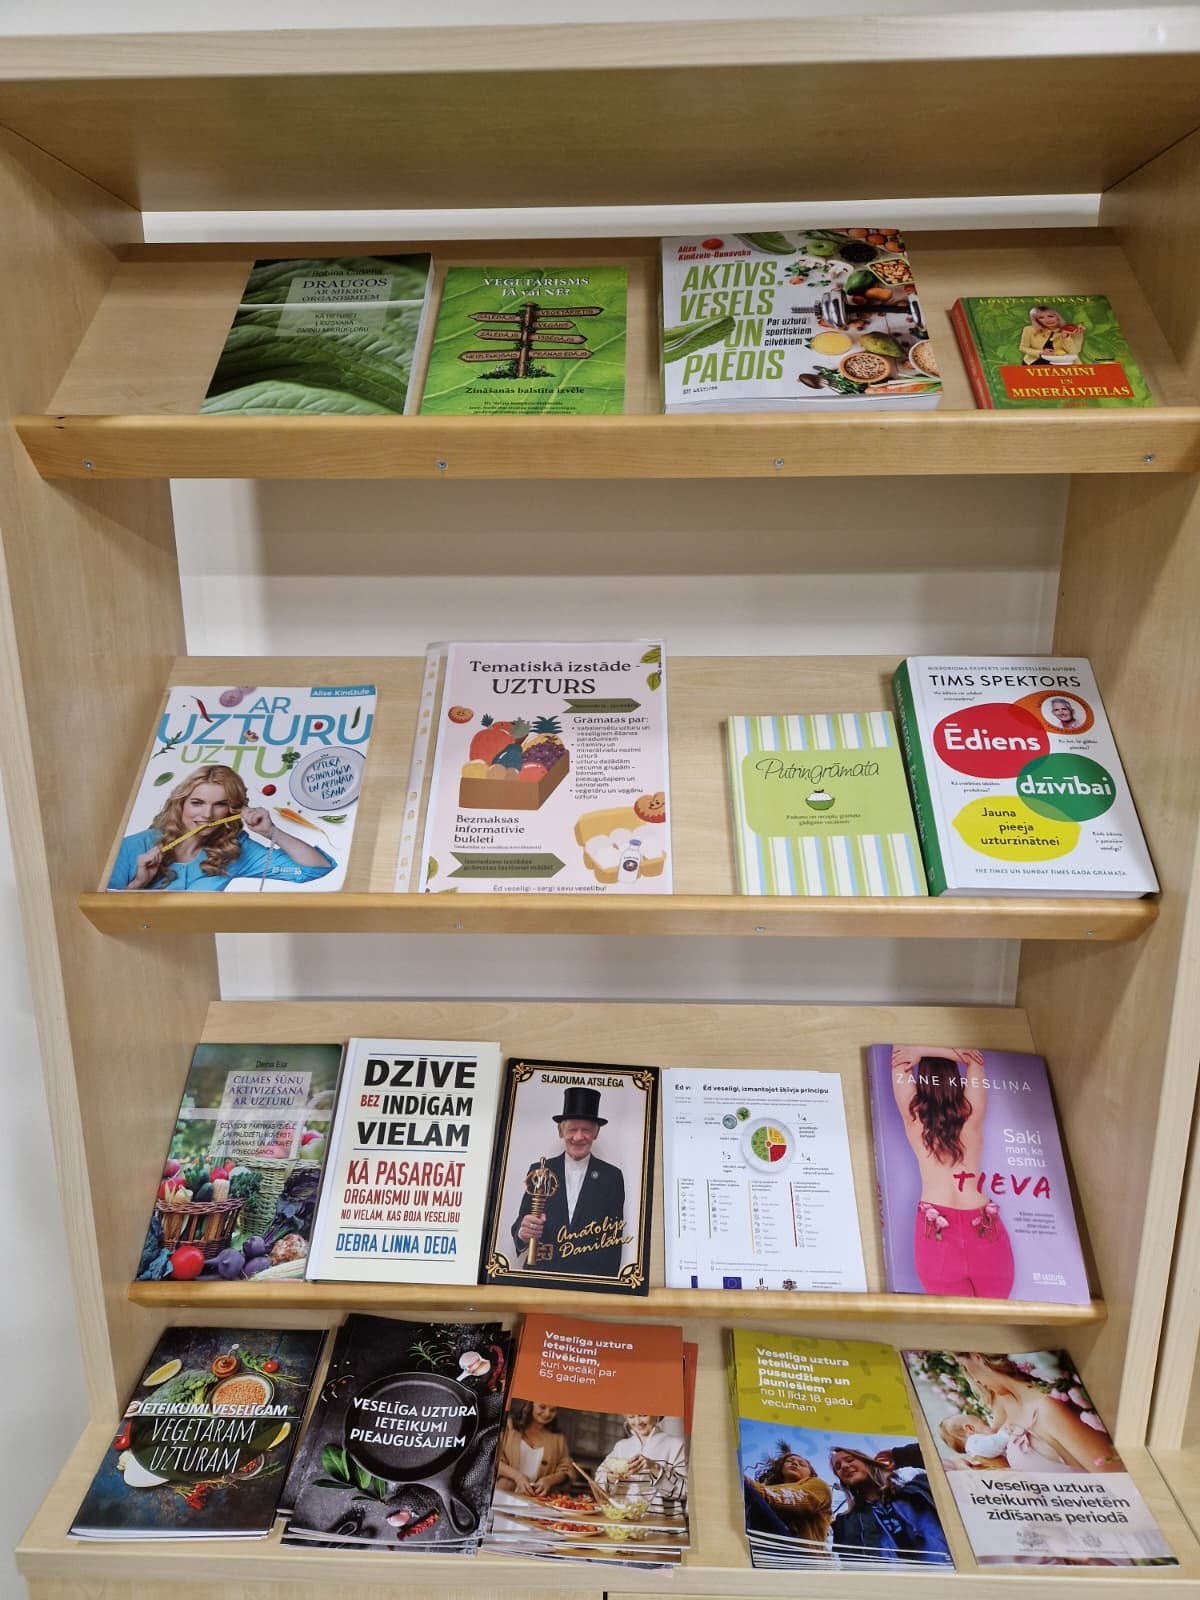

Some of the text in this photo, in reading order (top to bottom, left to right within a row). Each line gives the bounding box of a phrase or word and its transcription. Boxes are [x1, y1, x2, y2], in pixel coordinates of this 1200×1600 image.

[302, 278, 388, 289] DRAUGOS
[520, 288, 541, 298] vai
[680, 289, 776, 322] VESELS
[767, 316, 807, 326] Par uzturu
[723, 318, 765, 348] UN
[682, 347, 785, 386] PAĒDIS
[1026, 365, 1096, 377] VITAMĪNI
[1012, 385, 1131, 398] MINERĀLVIELAS
[470, 660, 631, 673] Tematiskā izstāde
[493, 678, 596, 695] UZTURS
[928, 674, 1081, 687] TIMS SPEKTORS
[248, 696, 292, 714] AR
[573, 716, 649, 725] Grāmatas par:
[157, 713, 374, 746] UZTURU
[943, 722, 1041, 751] Ēdiens
[1019, 775, 1112, 795] dzīvībai
[456, 815, 520, 824] Bezmaksas
[981, 807, 1017, 817] Jauna
[999, 822, 1034, 835] pieeja
[454, 835, 494, 844] bukleti
[981, 835, 1060, 847] uzturzinātnei
[364, 1057, 477, 1089] DZĪVE
[541, 1074, 586, 1086] SLAIDUMA
[896, 1073, 940, 1086] ZANE
[742, 1086, 779, 1095] izmantojot
[800, 1087, 829, 1096] principu
[232, 1096, 295, 1105] AR UZTURU
[360, 1093, 473, 1117] BEZ INDĪGĀM
[357, 1120, 470, 1147] VIELĀM
[1003, 1128, 1042, 1144] Saki
[1007, 1156, 1046, 1168] esmu
[346, 1158, 466, 1187] KĀ PASARGĀT
[953, 1170, 1051, 1200] TIEVA
[343, 1188, 410, 1206] ORGANISMU
[413, 1190, 429, 1206] UN
[341, 1208, 351, 1220] NO
[387, 1210, 401, 1222] KAS
[557, 1215, 628, 1243] Anatolijs
[335, 1232, 457, 1255] DEBRA LINNA DEDA
[543, 1339, 598, 1356] ieteikumi
[545, 1330, 634, 1350] Veselīga uztura
[541, 1349, 600, 1368] cilvēkiem,
[757, 1356, 814, 1373] ieteikumi
[810, 1355, 849, 1367] uztura
[539, 1368, 596, 1385] 65 gadiem
[540, 1359, 560, 1370] kuri
[598, 1369, 617, 1378] par
[758, 1367, 851, 1386] pusaudžiem un
[759, 1375, 826, 1394] jauniešiem
[760, 1388, 775, 1397] no
[777, 1388, 785, 1398] 11
[810, 1393, 822, 1403] 18
[824, 1395, 853, 1408] gadu
[761, 1399, 817, 1413] vecumam
[138, 1401, 289, 1416] IETEIKUMI VESELĪGAM
[353, 1397, 477, 1418] VESELĪGA UZTURA
[375, 1416, 448, 1433] IETEIKUMI
[350, 1428, 466, 1449] PIEAUGUŠAJIEM
[150, 1446, 241, 1474] UZTURAM
[981, 1479, 1105, 1495] Veselīga uztura
[970, 1492, 1130, 1509] ieteikumi sievietēm
[1065, 1510, 1128, 1526] periodā
